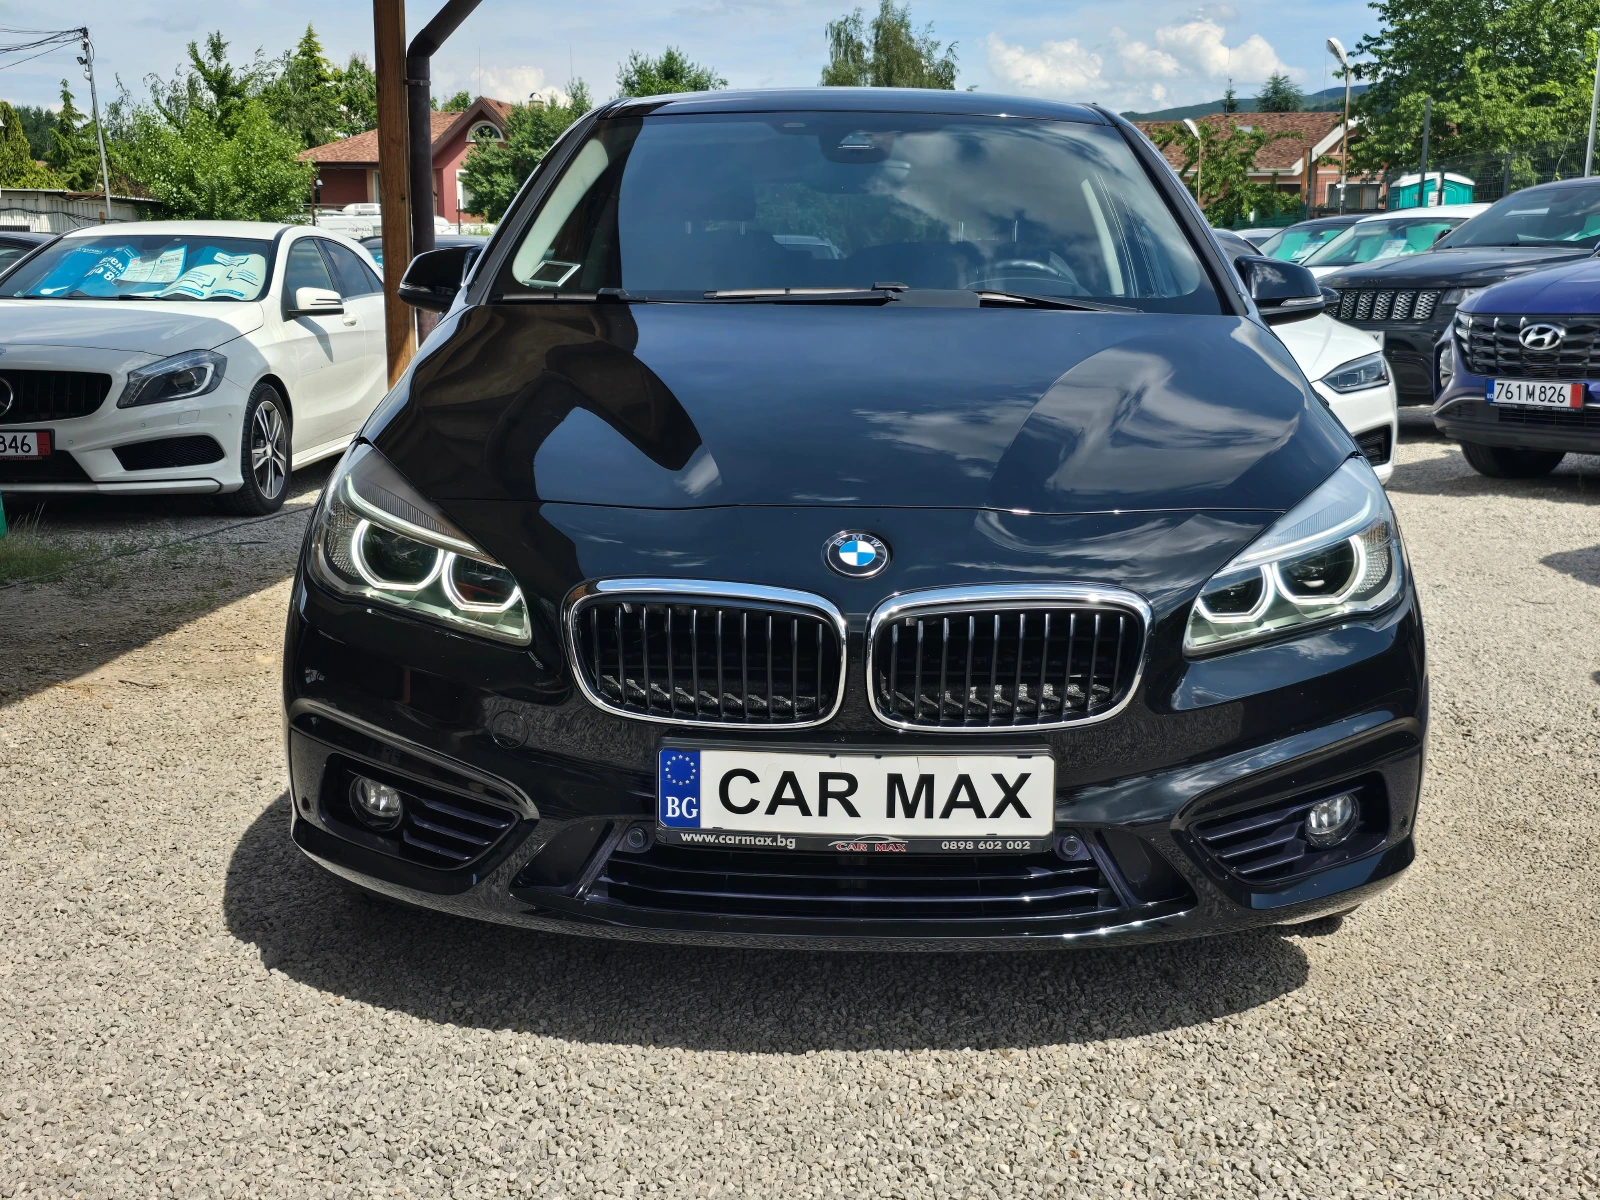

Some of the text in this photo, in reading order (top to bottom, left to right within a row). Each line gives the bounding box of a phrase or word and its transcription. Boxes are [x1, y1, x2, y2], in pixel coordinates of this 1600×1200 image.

[1496, 383, 1566, 403] 761M826
[834, 533, 881, 548] BMW
[718, 768, 1032, 819] CAR MAX
[665, 796, 699, 818] BG
[680, 833, 796, 849] www.carmax.bg
[836, 843, 907, 852] CAR MAX
[941, 841, 1031, 850] 0898 602 002
